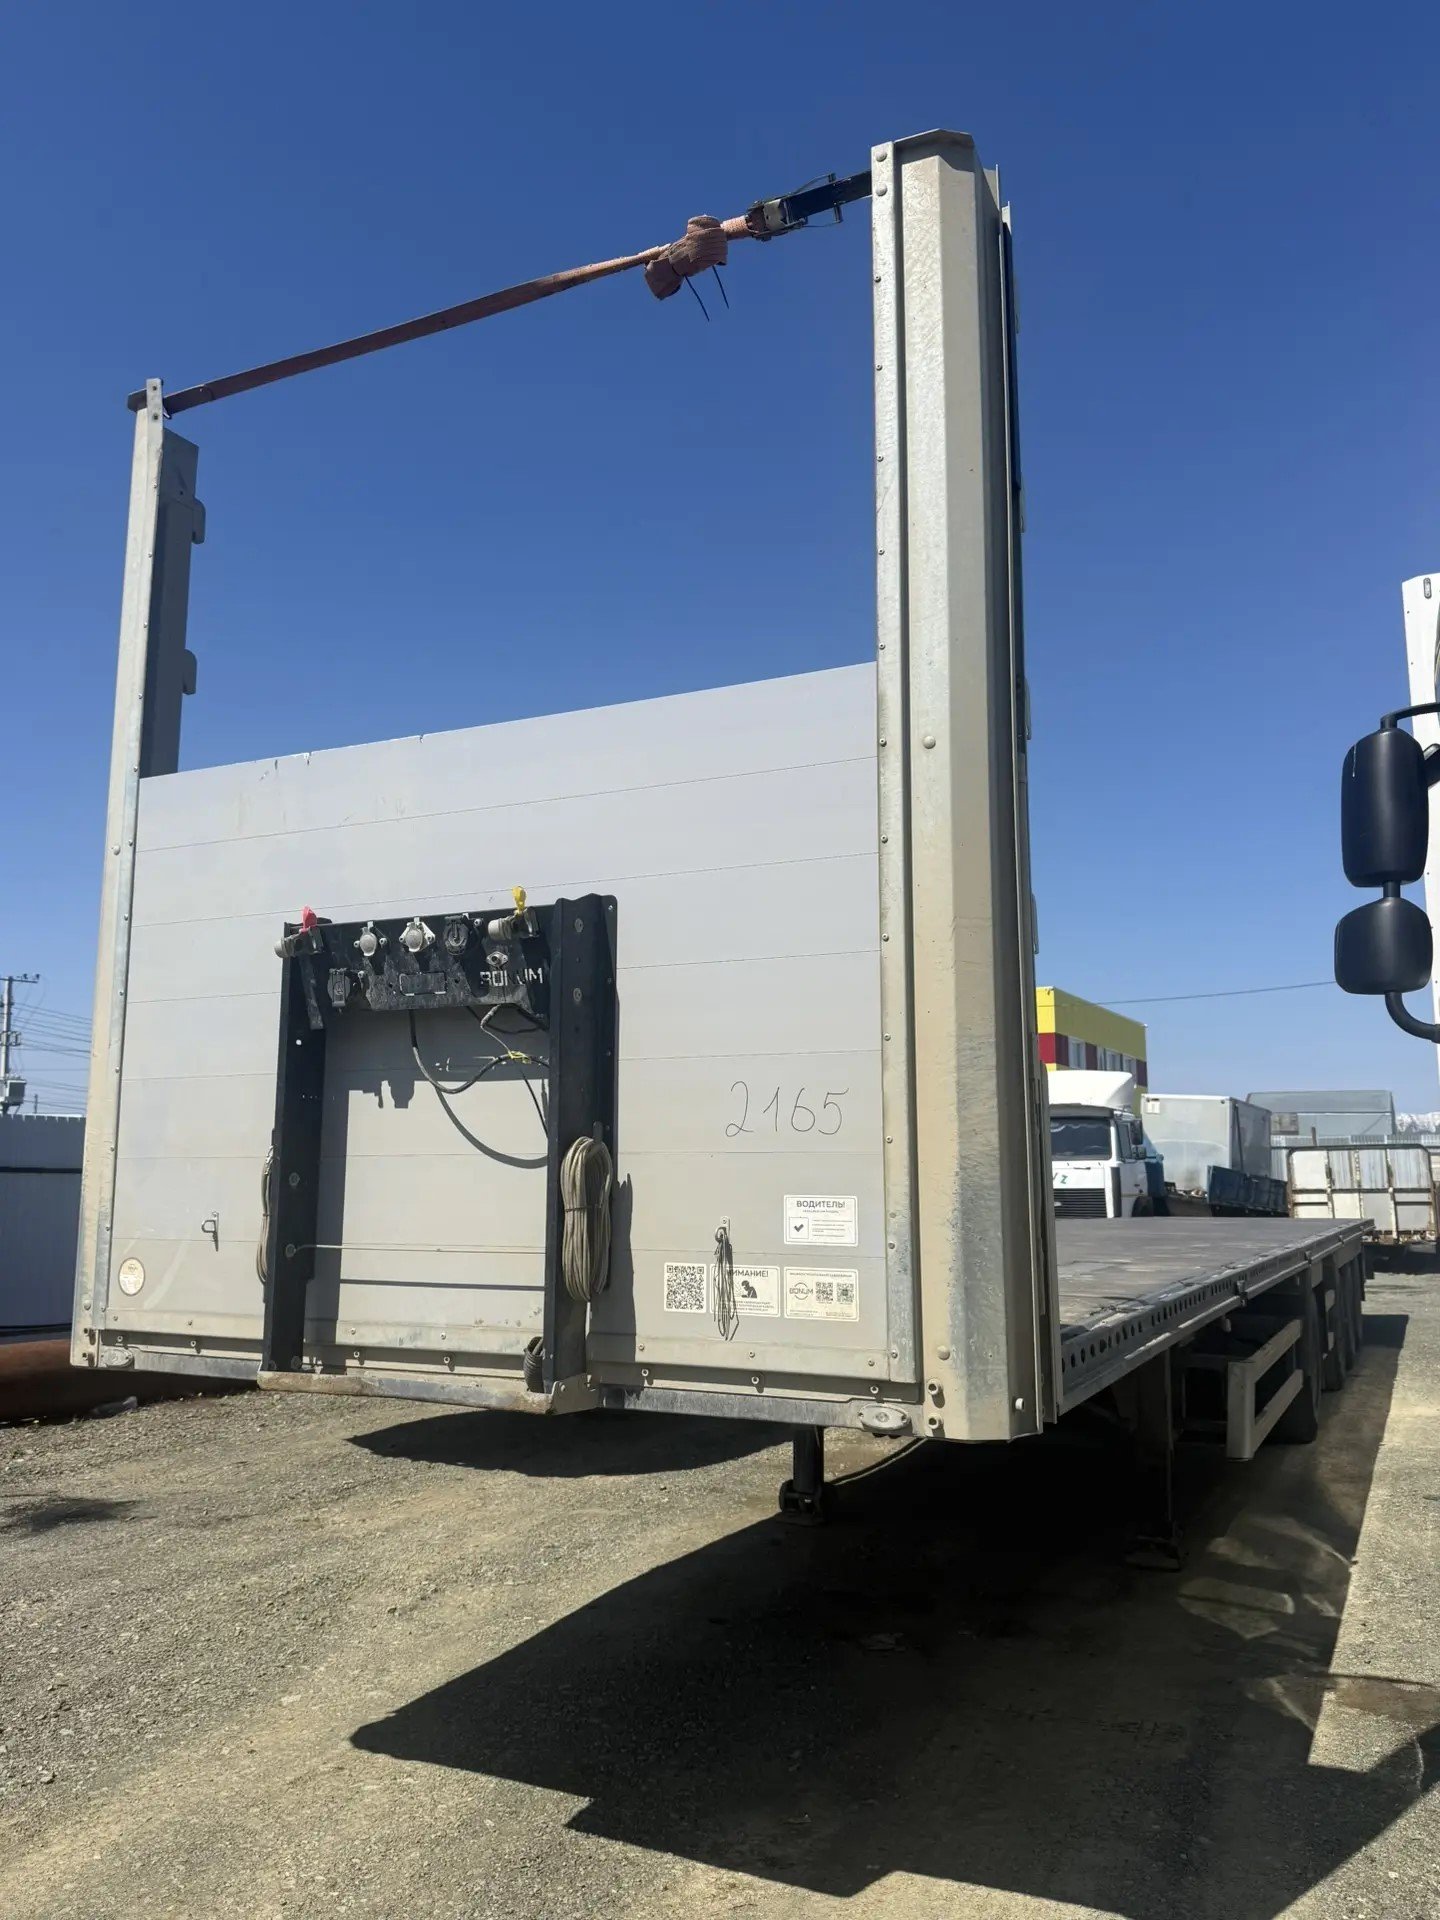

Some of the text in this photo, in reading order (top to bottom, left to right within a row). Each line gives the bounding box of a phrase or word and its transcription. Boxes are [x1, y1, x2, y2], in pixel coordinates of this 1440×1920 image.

[725, 1080, 849, 1137] 2165
[796, 1200, 846, 1209] ВОДИТЕЛЬ!
[727, 1269, 769, 1278] ИМАНИЕ!
